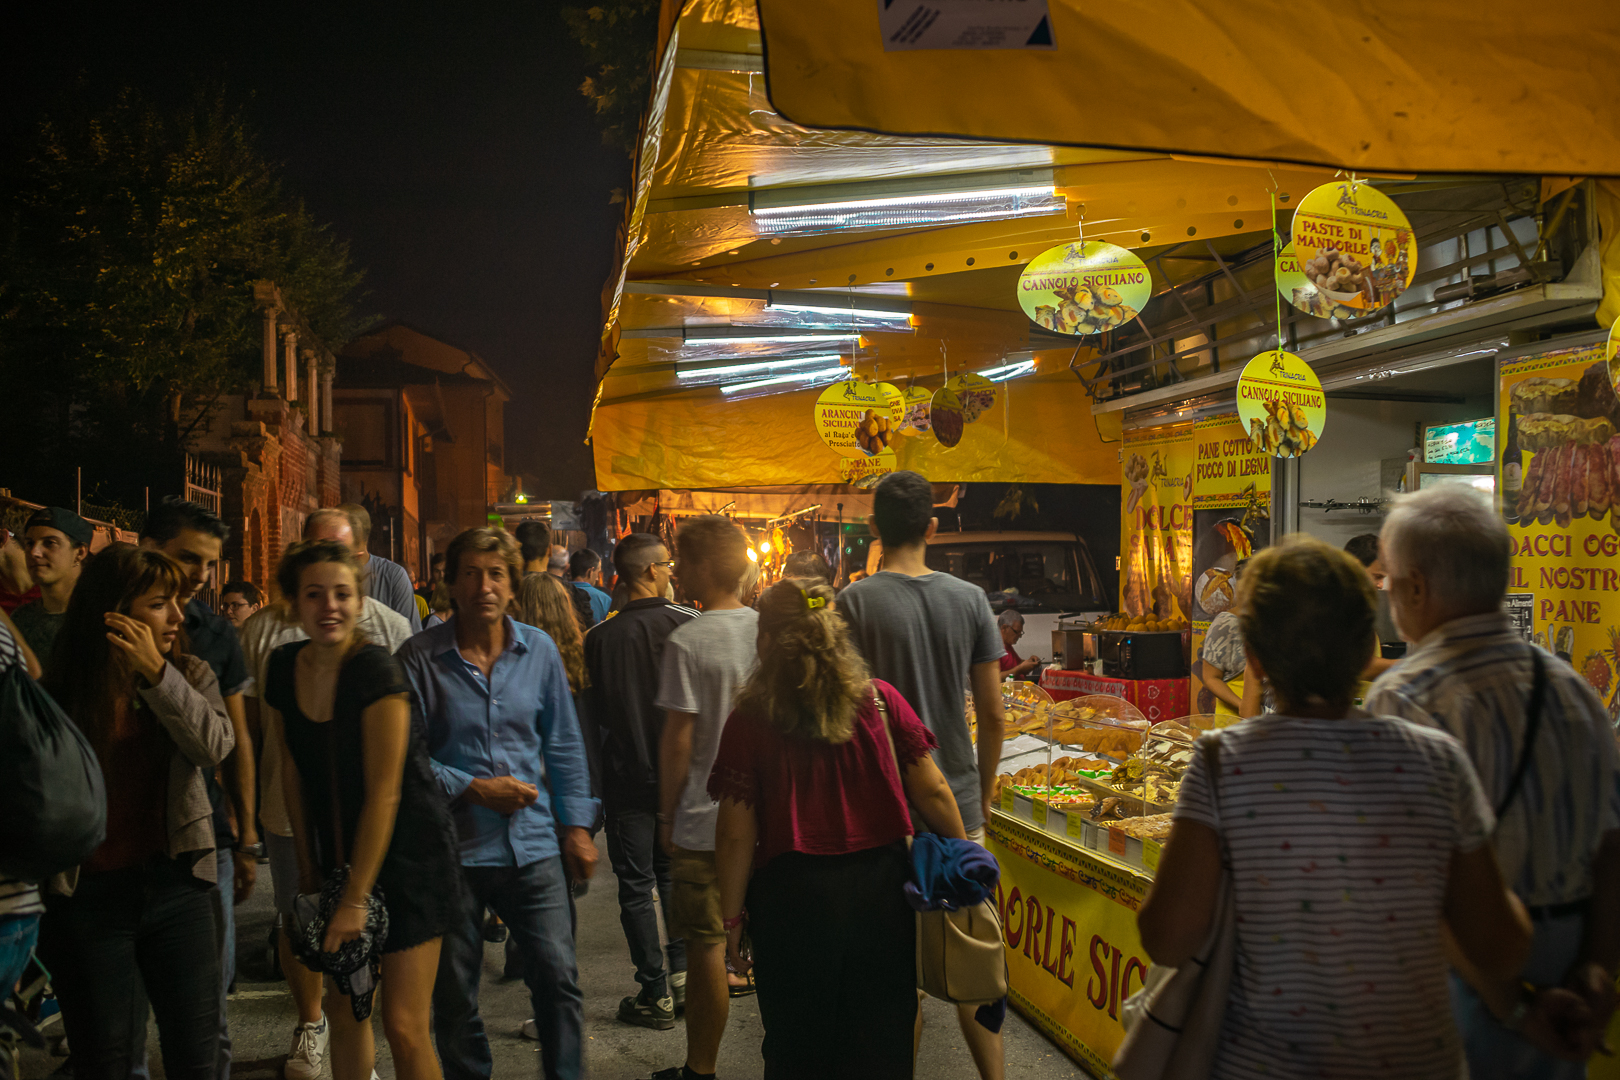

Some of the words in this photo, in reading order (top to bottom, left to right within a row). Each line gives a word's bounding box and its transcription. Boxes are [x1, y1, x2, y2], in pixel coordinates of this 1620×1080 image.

[1350, 206, 1388, 220] TRINACRIA
[1302, 220, 1344, 237] PASTE
[1348, 227, 1363, 240] DI
[1296, 234, 1368, 255] MANDORLE
[1022, 276, 1079, 291] CANNOLO
[1083, 272, 1144, 287] SICILIANO
[1241, 385, 1280, 402] CANNOLO
[1282, 391, 1322, 408] SICILIANO
[821, 408, 862, 419] ARANCINI
[1198, 442, 1219, 460] PANE
[1222, 437, 1253, 457] COTTO
[1197, 461, 1224, 483] FUOCO
[1227, 460, 1237, 477] DI
[1240, 457, 1269, 476] LEGNA
[1539, 567, 1620, 591] NOSTR
[1540, 599, 1601, 624] PANE
